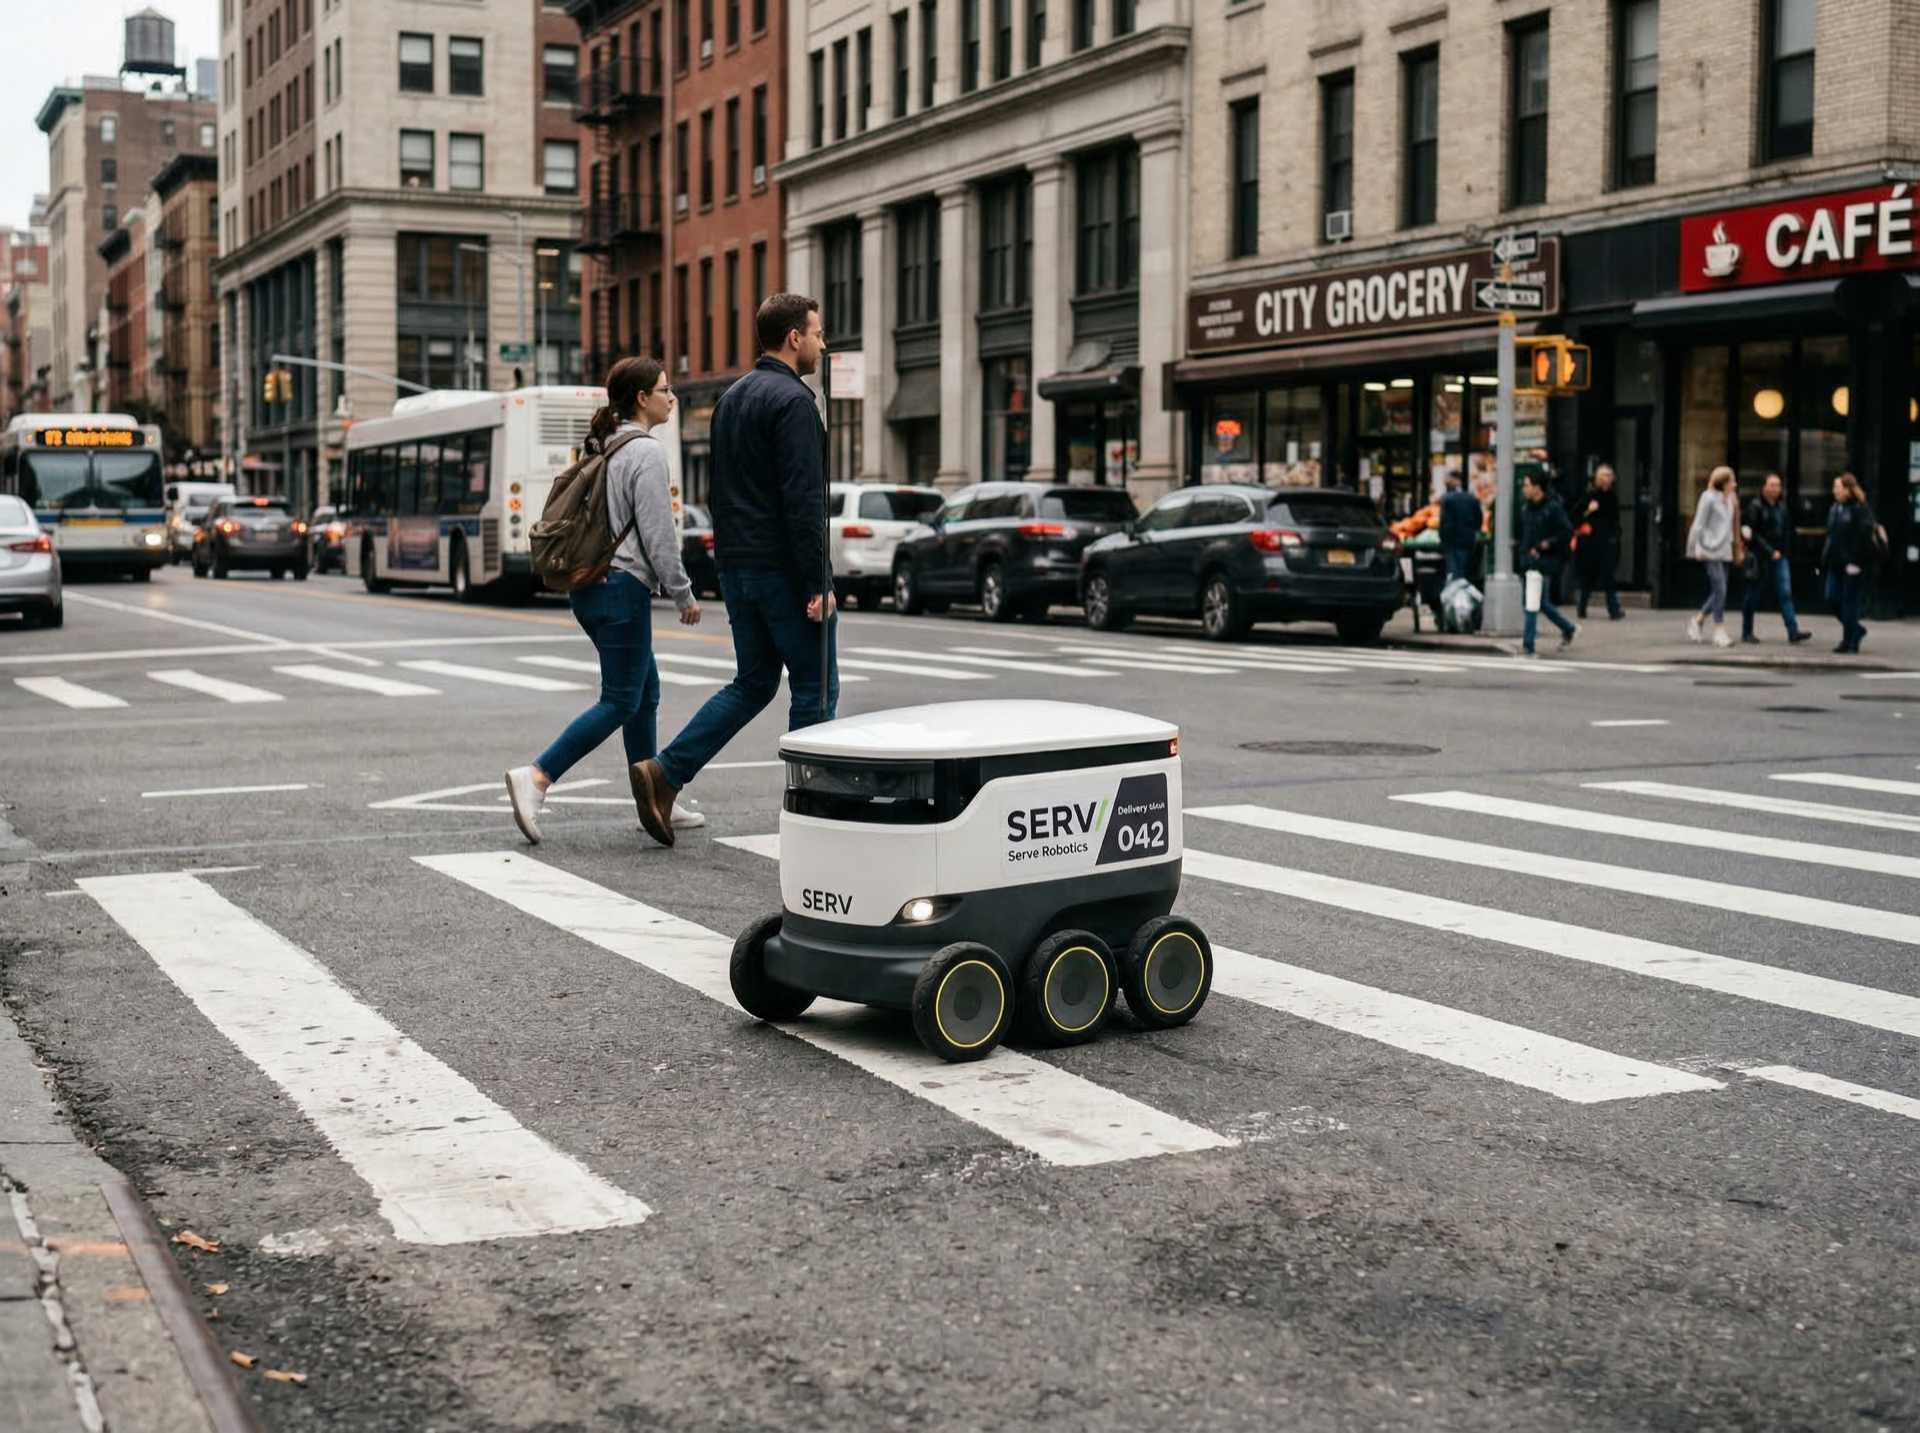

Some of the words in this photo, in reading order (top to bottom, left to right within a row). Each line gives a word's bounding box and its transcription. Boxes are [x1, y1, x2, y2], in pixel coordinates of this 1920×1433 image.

[1765, 183, 1914, 268] CAFÉ
[1255, 285, 1318, 337] CITY
[1325, 263, 1469, 328] GROCERY
[1117, 804, 1148, 816] Delivery
[1117, 820, 1165, 852] 042
[1008, 849, 1040, 862] Serve
[1042, 841, 1089, 857] Robotics
[802, 888, 853, 915] SERV
